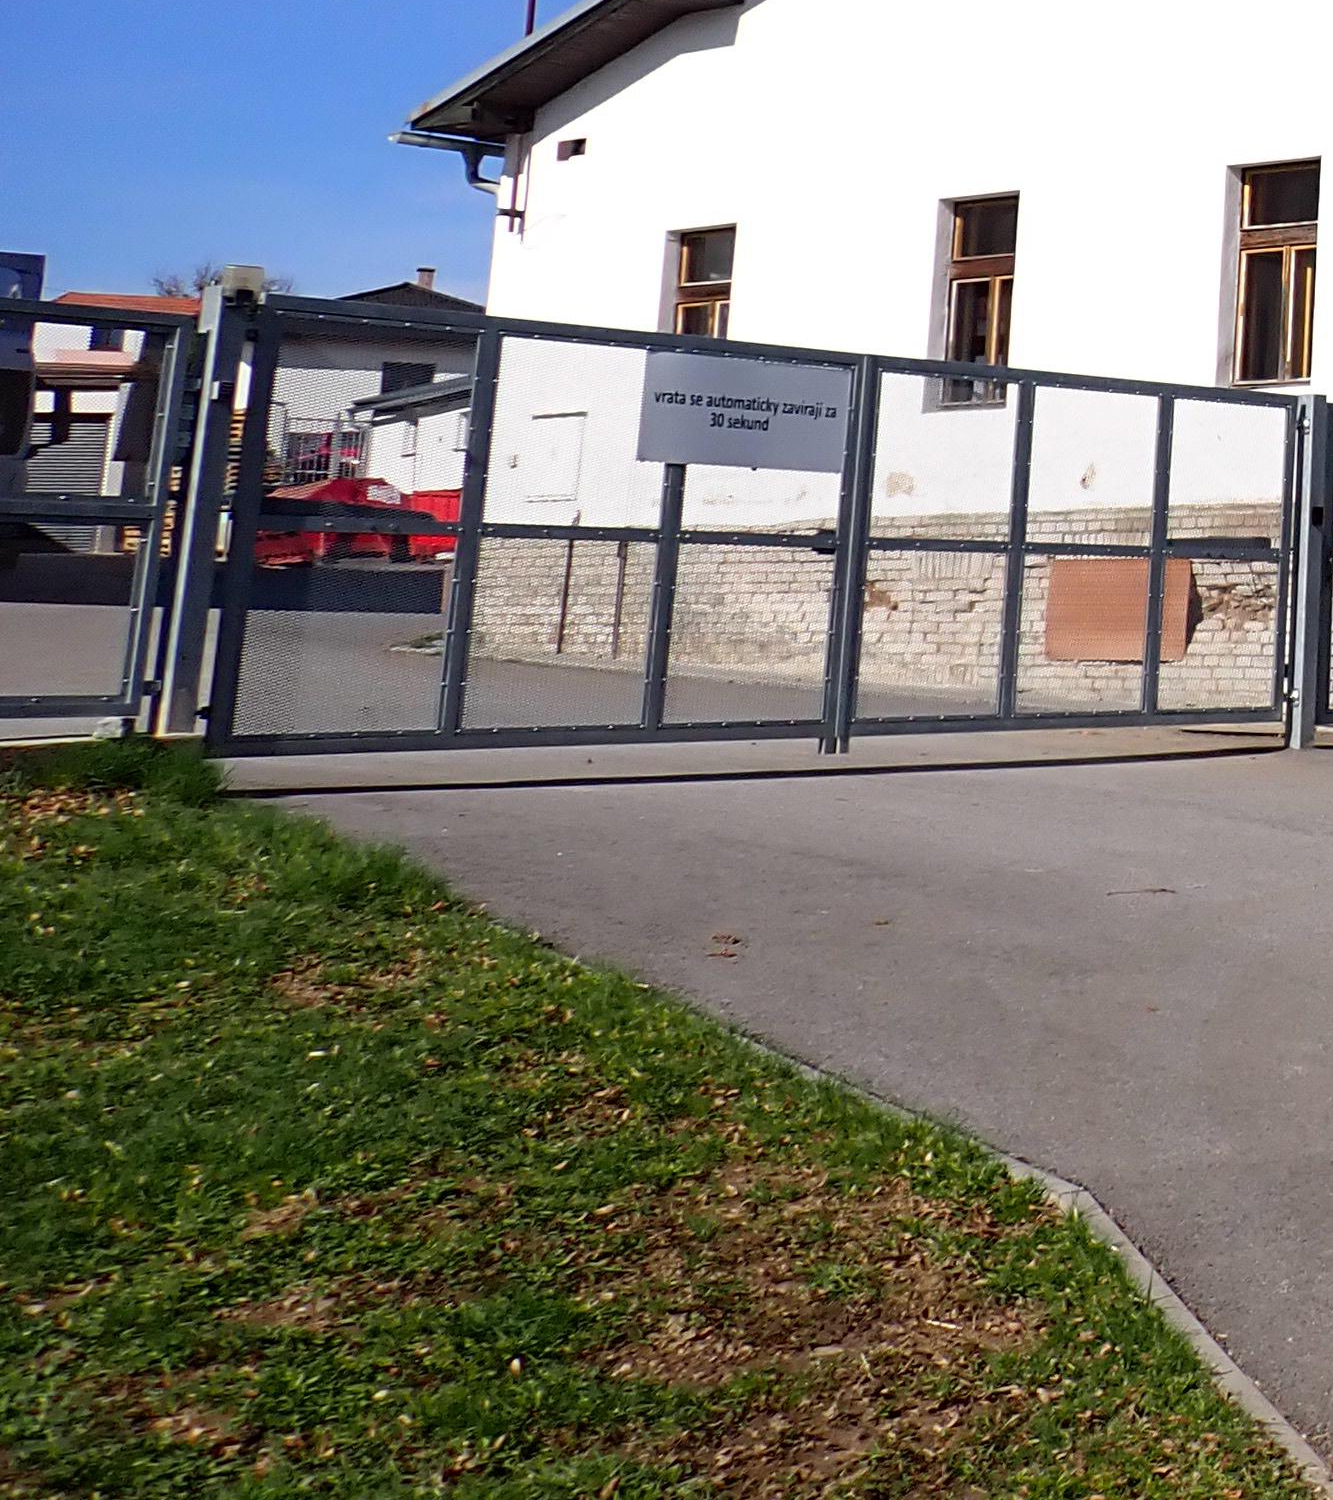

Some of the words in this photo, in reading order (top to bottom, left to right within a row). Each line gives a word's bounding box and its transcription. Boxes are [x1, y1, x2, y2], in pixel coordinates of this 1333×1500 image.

[654, 391, 687, 406] vrata
[690, 393, 703, 407] se
[825, 406, 837, 419] za
[709, 412, 724, 428] 30
[727, 414, 769, 431] sekund
